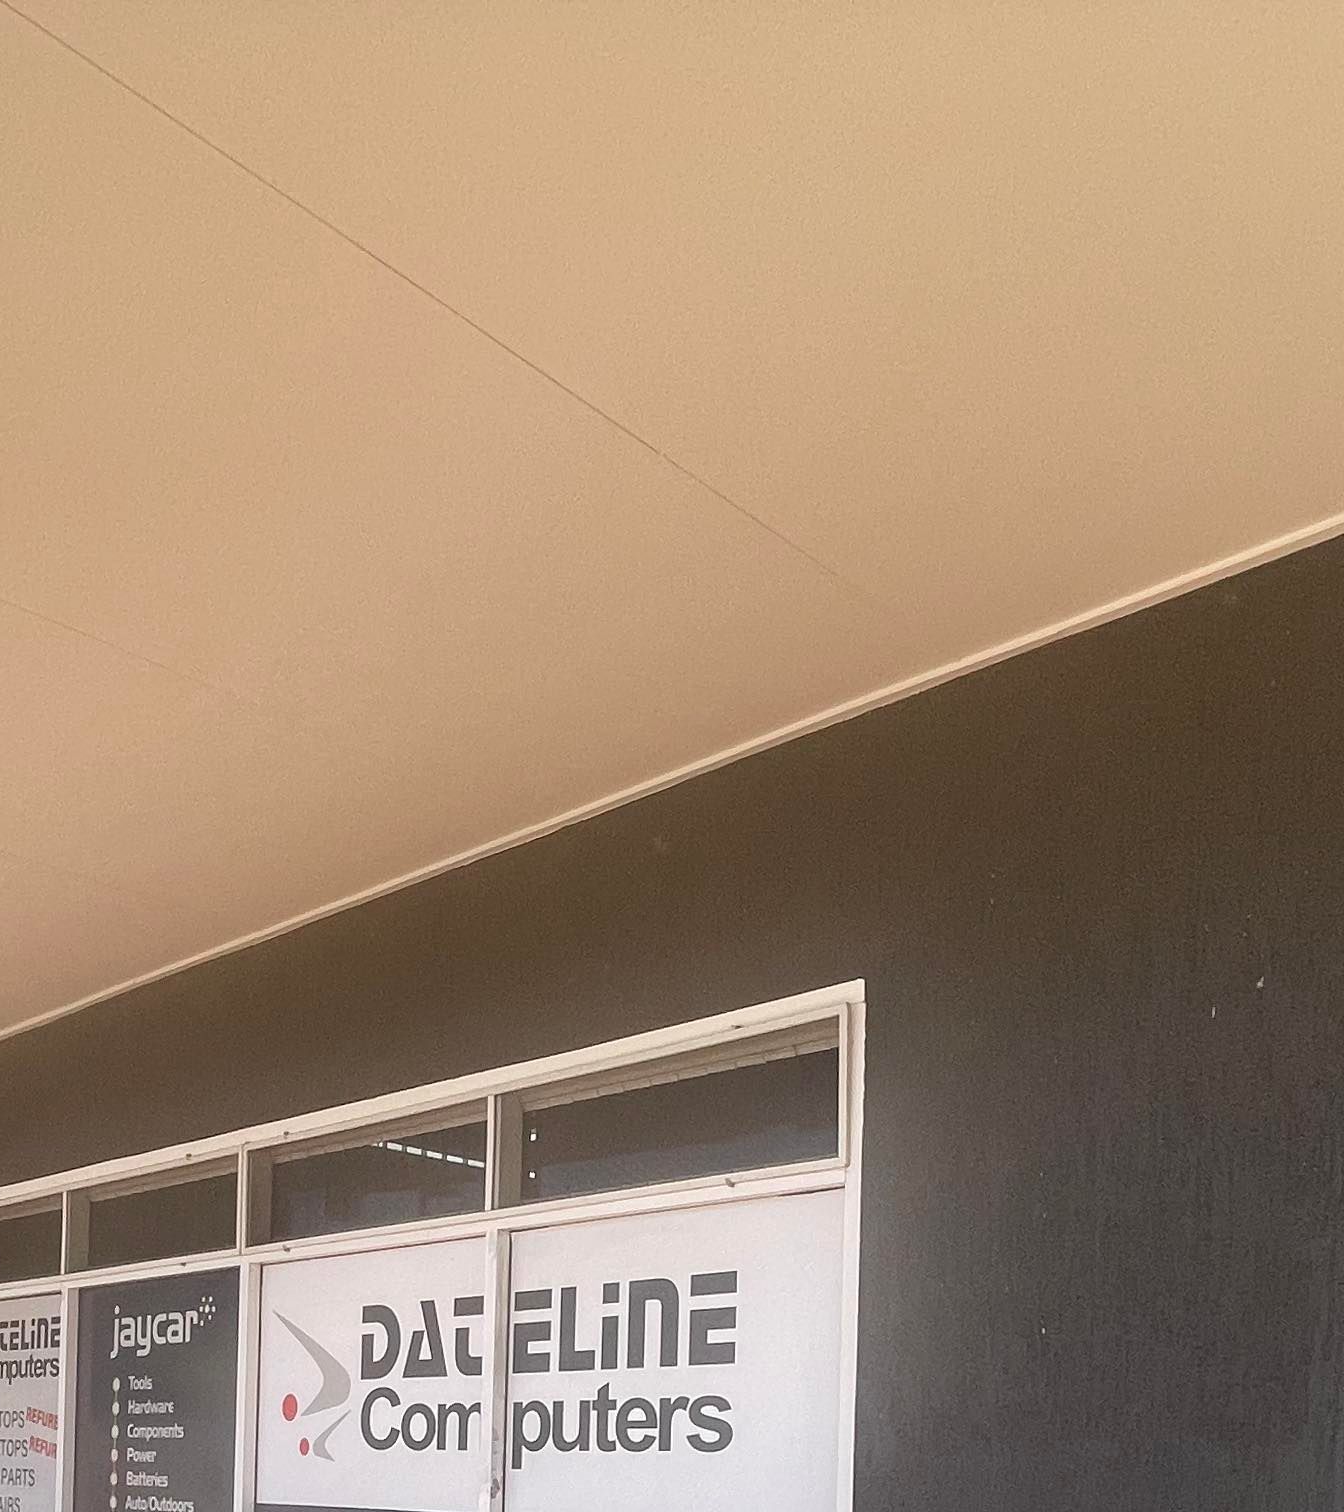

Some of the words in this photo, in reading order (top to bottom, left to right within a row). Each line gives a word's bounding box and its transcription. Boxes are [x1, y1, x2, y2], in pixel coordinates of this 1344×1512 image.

[110, 1305, 199, 1359] jaycar
[128, 1375, 153, 1390] Tools
[127, 1400, 174, 1414] Hardware
[127, 1423, 184, 1441] Components
[360, 1383, 733, 1470] Computers
[29, 1436, 57, 1459] REFUR
[127, 1447, 157, 1462] Power
[1, 1467, 35, 1487] PARTS
[126, 1471, 169, 1487] Batteries
